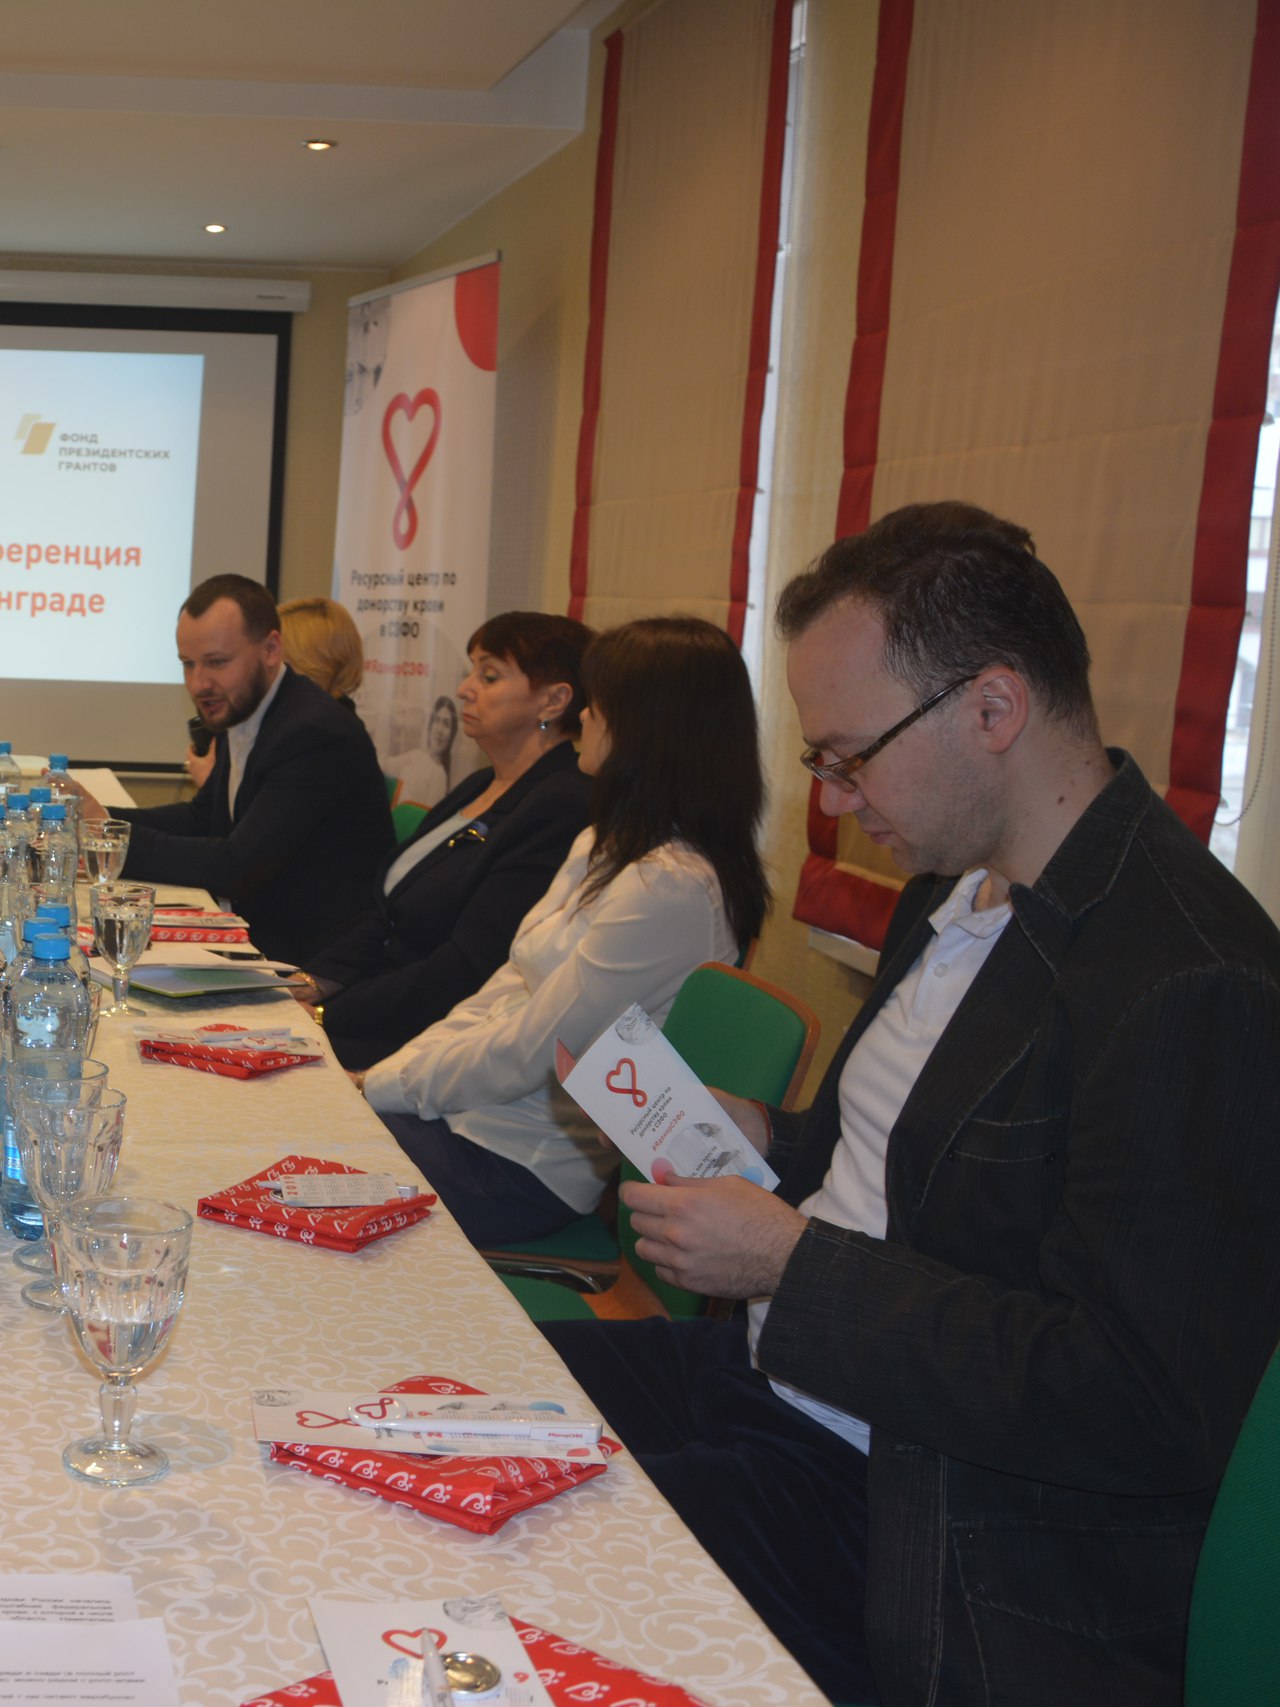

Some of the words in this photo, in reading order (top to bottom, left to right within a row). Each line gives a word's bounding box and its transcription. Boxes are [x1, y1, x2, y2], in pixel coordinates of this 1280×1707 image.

[59, 433, 98, 445] ФОНД
[58, 447, 171, 460] ПРЕЗИДЕНТСКИХ
[58, 460, 117, 473] ГРАНТОВ
[350, 568, 405, 590] Ресурсный
[407, 571, 440, 590] центр
[442, 572, 457, 586] по
[356, 599, 410, 615] донорству
[412, 600, 445, 615] крови
[630, 1106, 652, 1136] Ресурсный
[651, 1092, 666, 1109] центр
[654, 1112, 668, 1129] СЗФО
[639, 1111, 660, 1138] донорству
